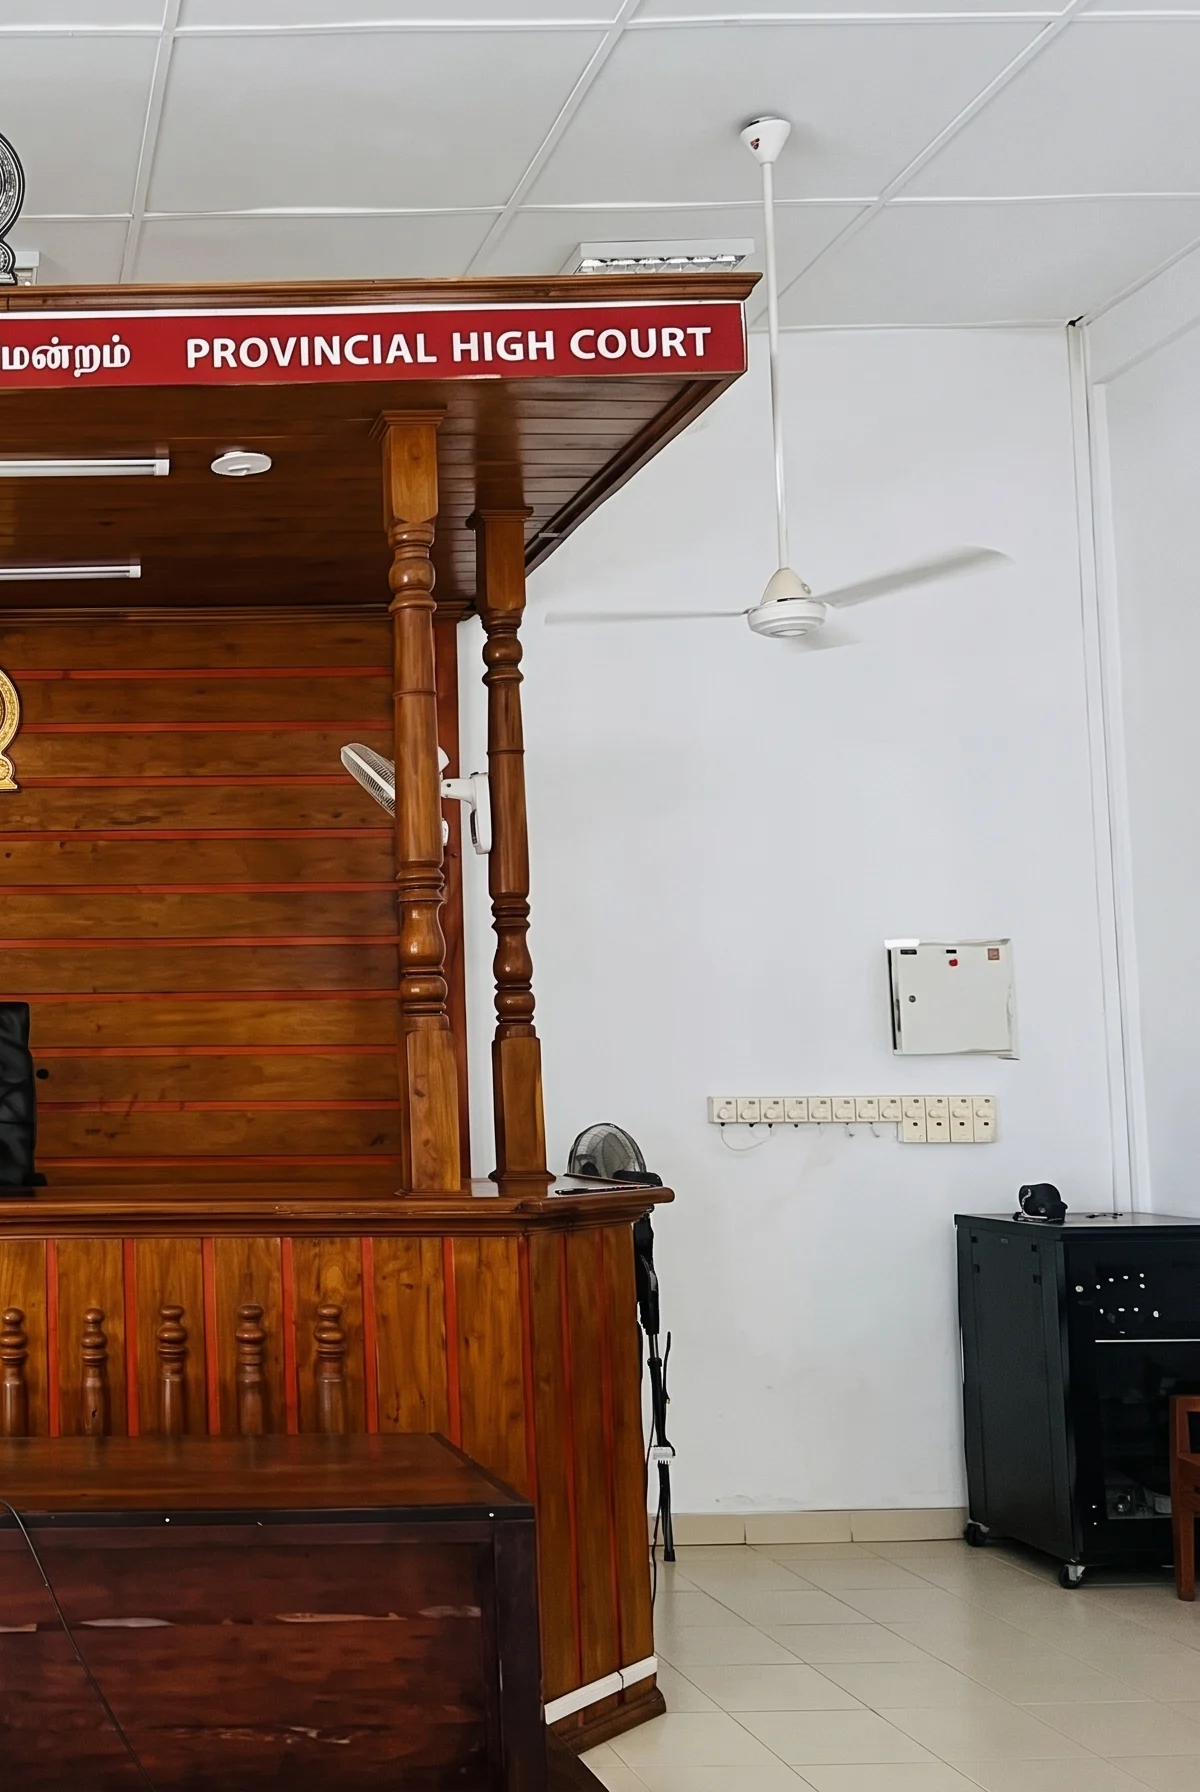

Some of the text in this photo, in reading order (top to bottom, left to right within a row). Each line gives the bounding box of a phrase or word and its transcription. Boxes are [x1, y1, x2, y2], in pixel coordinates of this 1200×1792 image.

[186, 327, 712, 369] PROVINCIAL HIGH COURT
